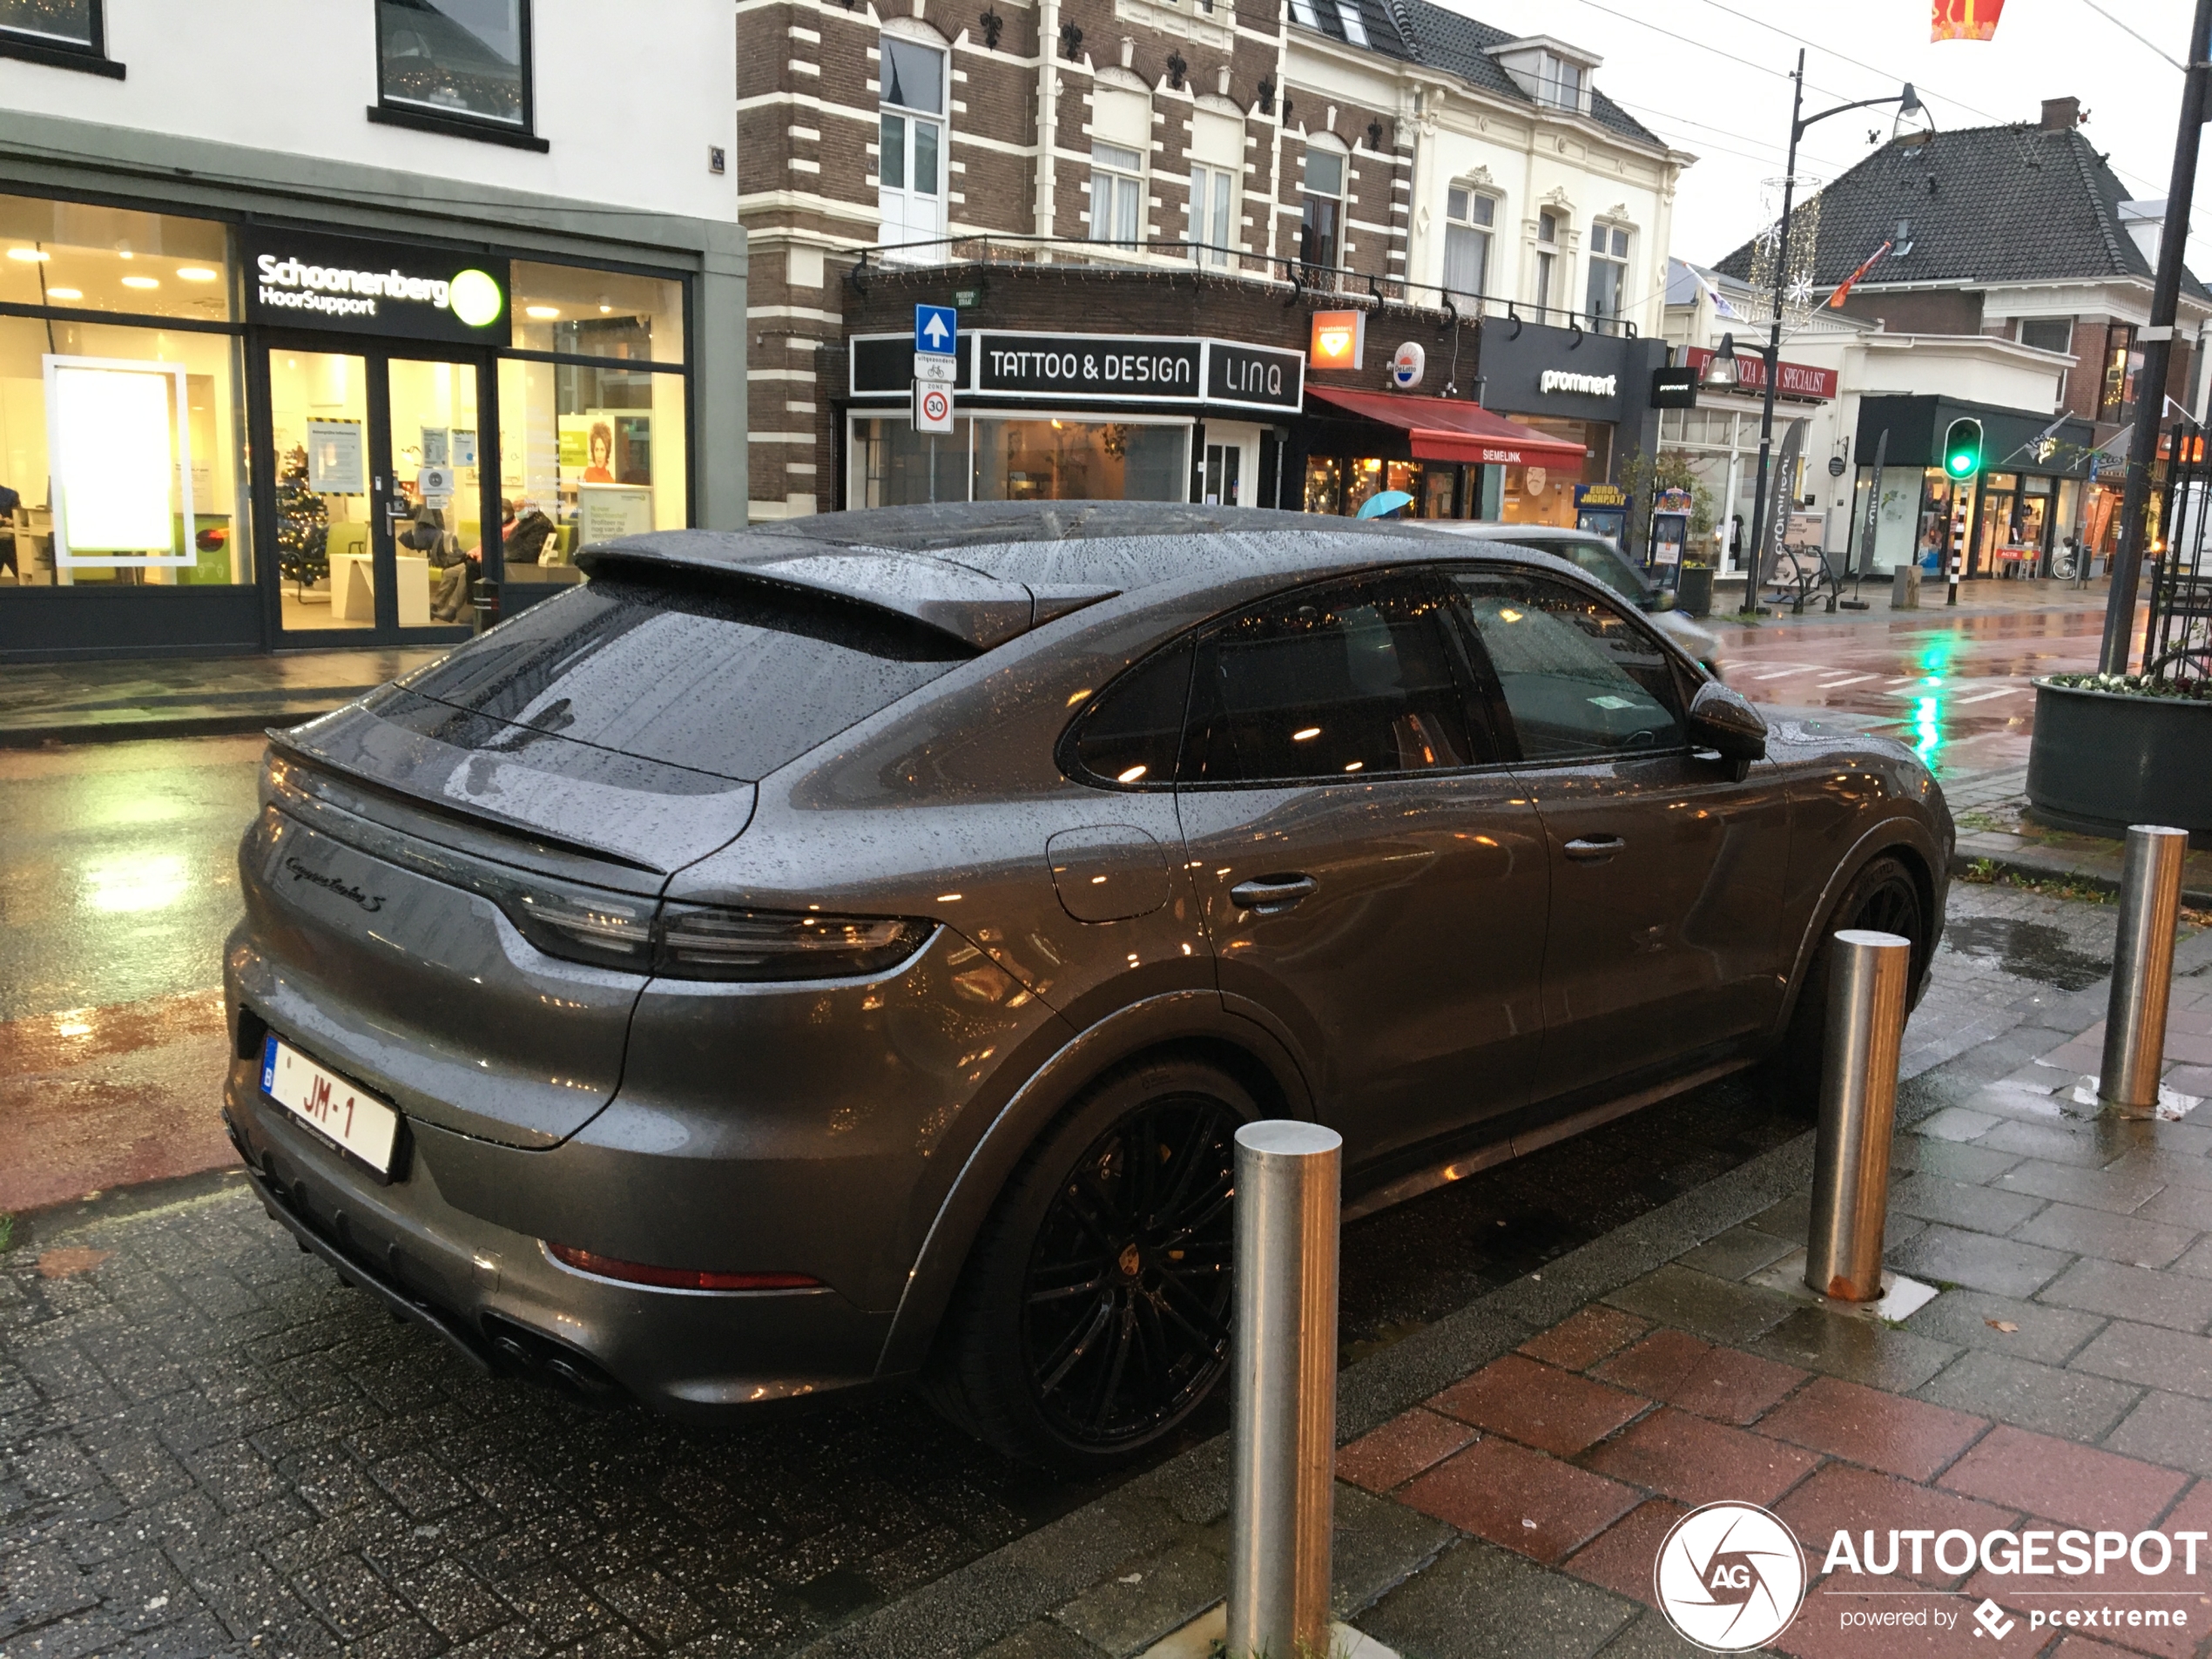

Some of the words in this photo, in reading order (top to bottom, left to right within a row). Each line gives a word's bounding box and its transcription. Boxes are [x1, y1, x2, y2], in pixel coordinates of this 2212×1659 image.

[257, 254, 450, 307] Schoonenberg
[259, 286, 375, 315] HoorSupport
[918, 356, 954, 365] uitgezonderd
[990, 351, 1077, 378] TATTOO
[1083, 354, 1099, 380] &
[1105, 354, 1190, 382] DESIGN
[1226, 358, 1282, 395] LINQ
[1541, 369, 1617, 397] prominent
[1659, 383, 1689, 392] prominent
[1783, 367, 1826, 393] SPECIALIST
[928, 400, 943, 412] 30
[1482, 448, 1521, 463] SIEMELINK
[264, 1067, 273, 1088] B
